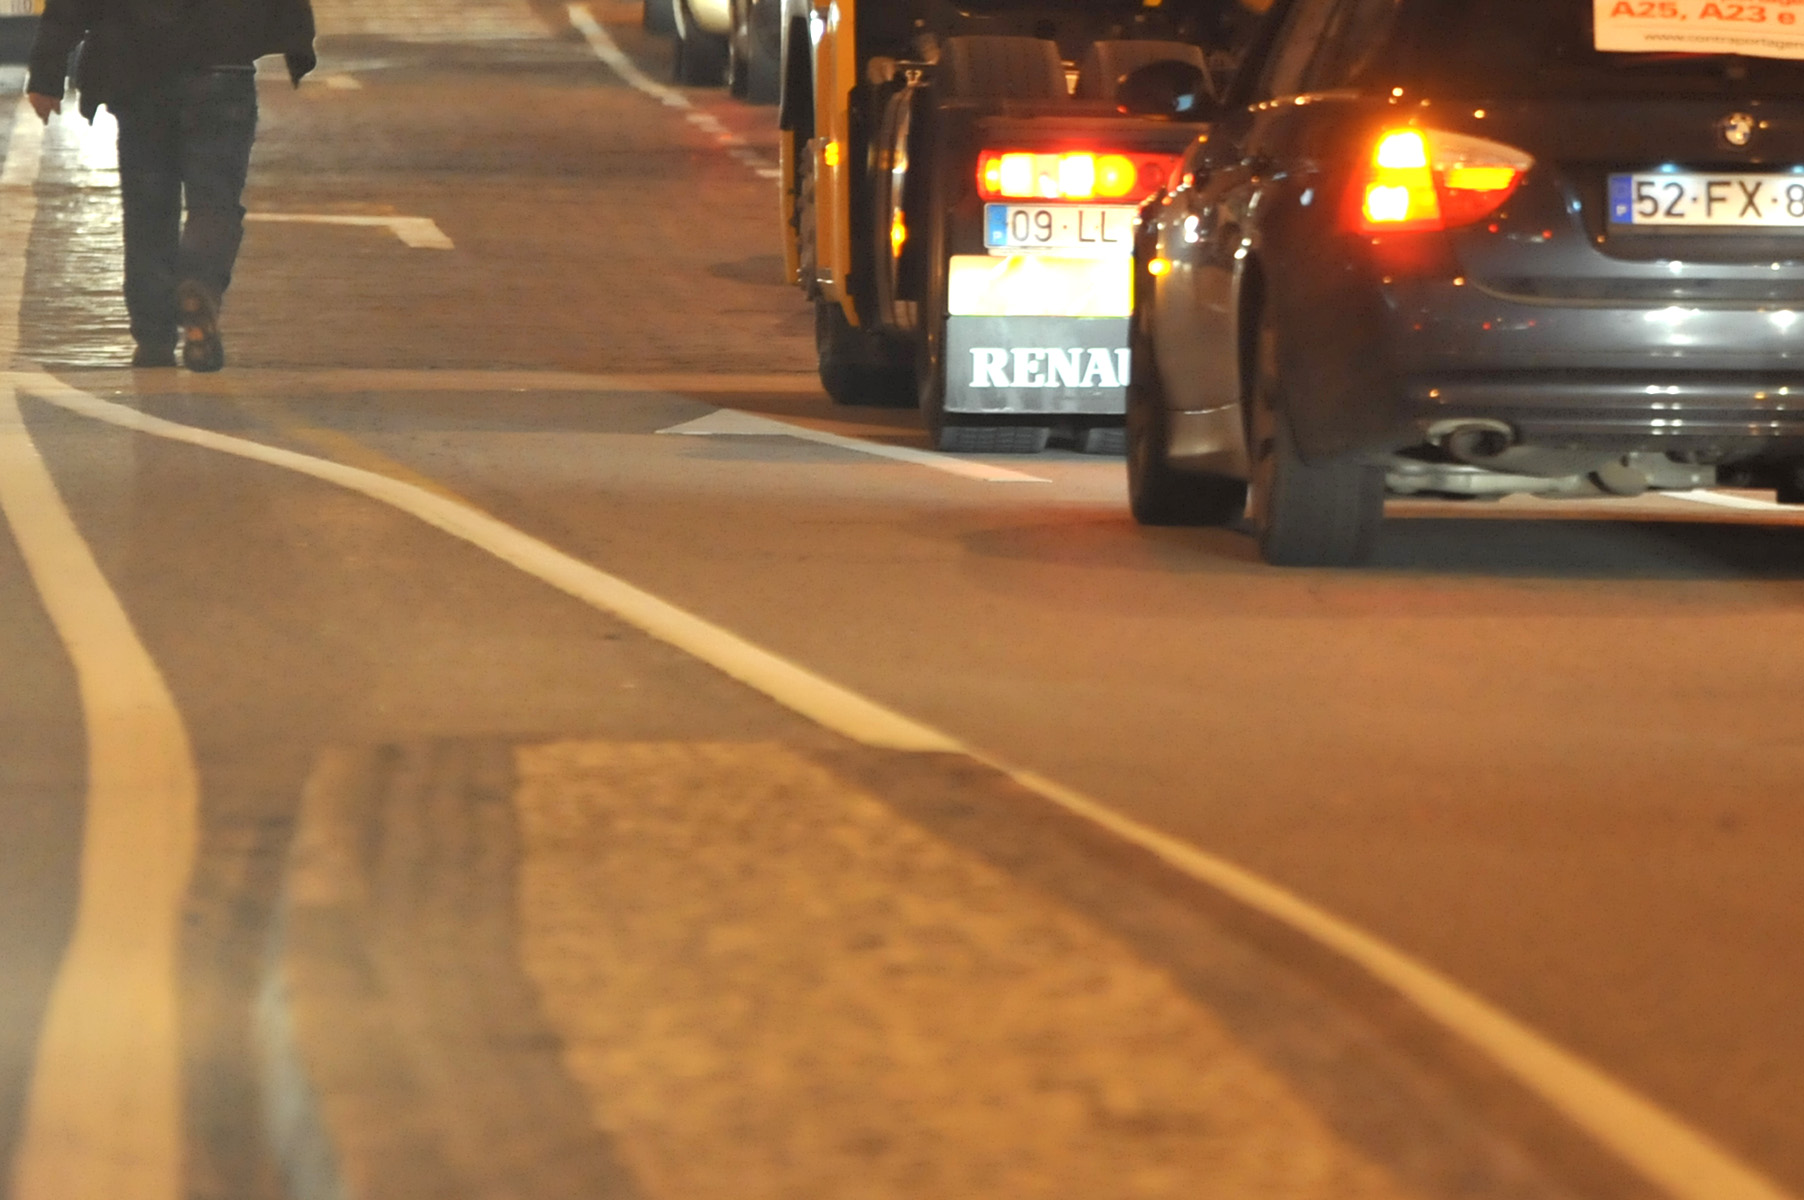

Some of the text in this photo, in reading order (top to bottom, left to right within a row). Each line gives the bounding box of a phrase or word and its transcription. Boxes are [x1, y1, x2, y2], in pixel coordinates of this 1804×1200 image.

[1610, 1, 1687, 21] A25,
[1698, 3, 1767, 23] A23
[1777, 10, 1796, 25] e
